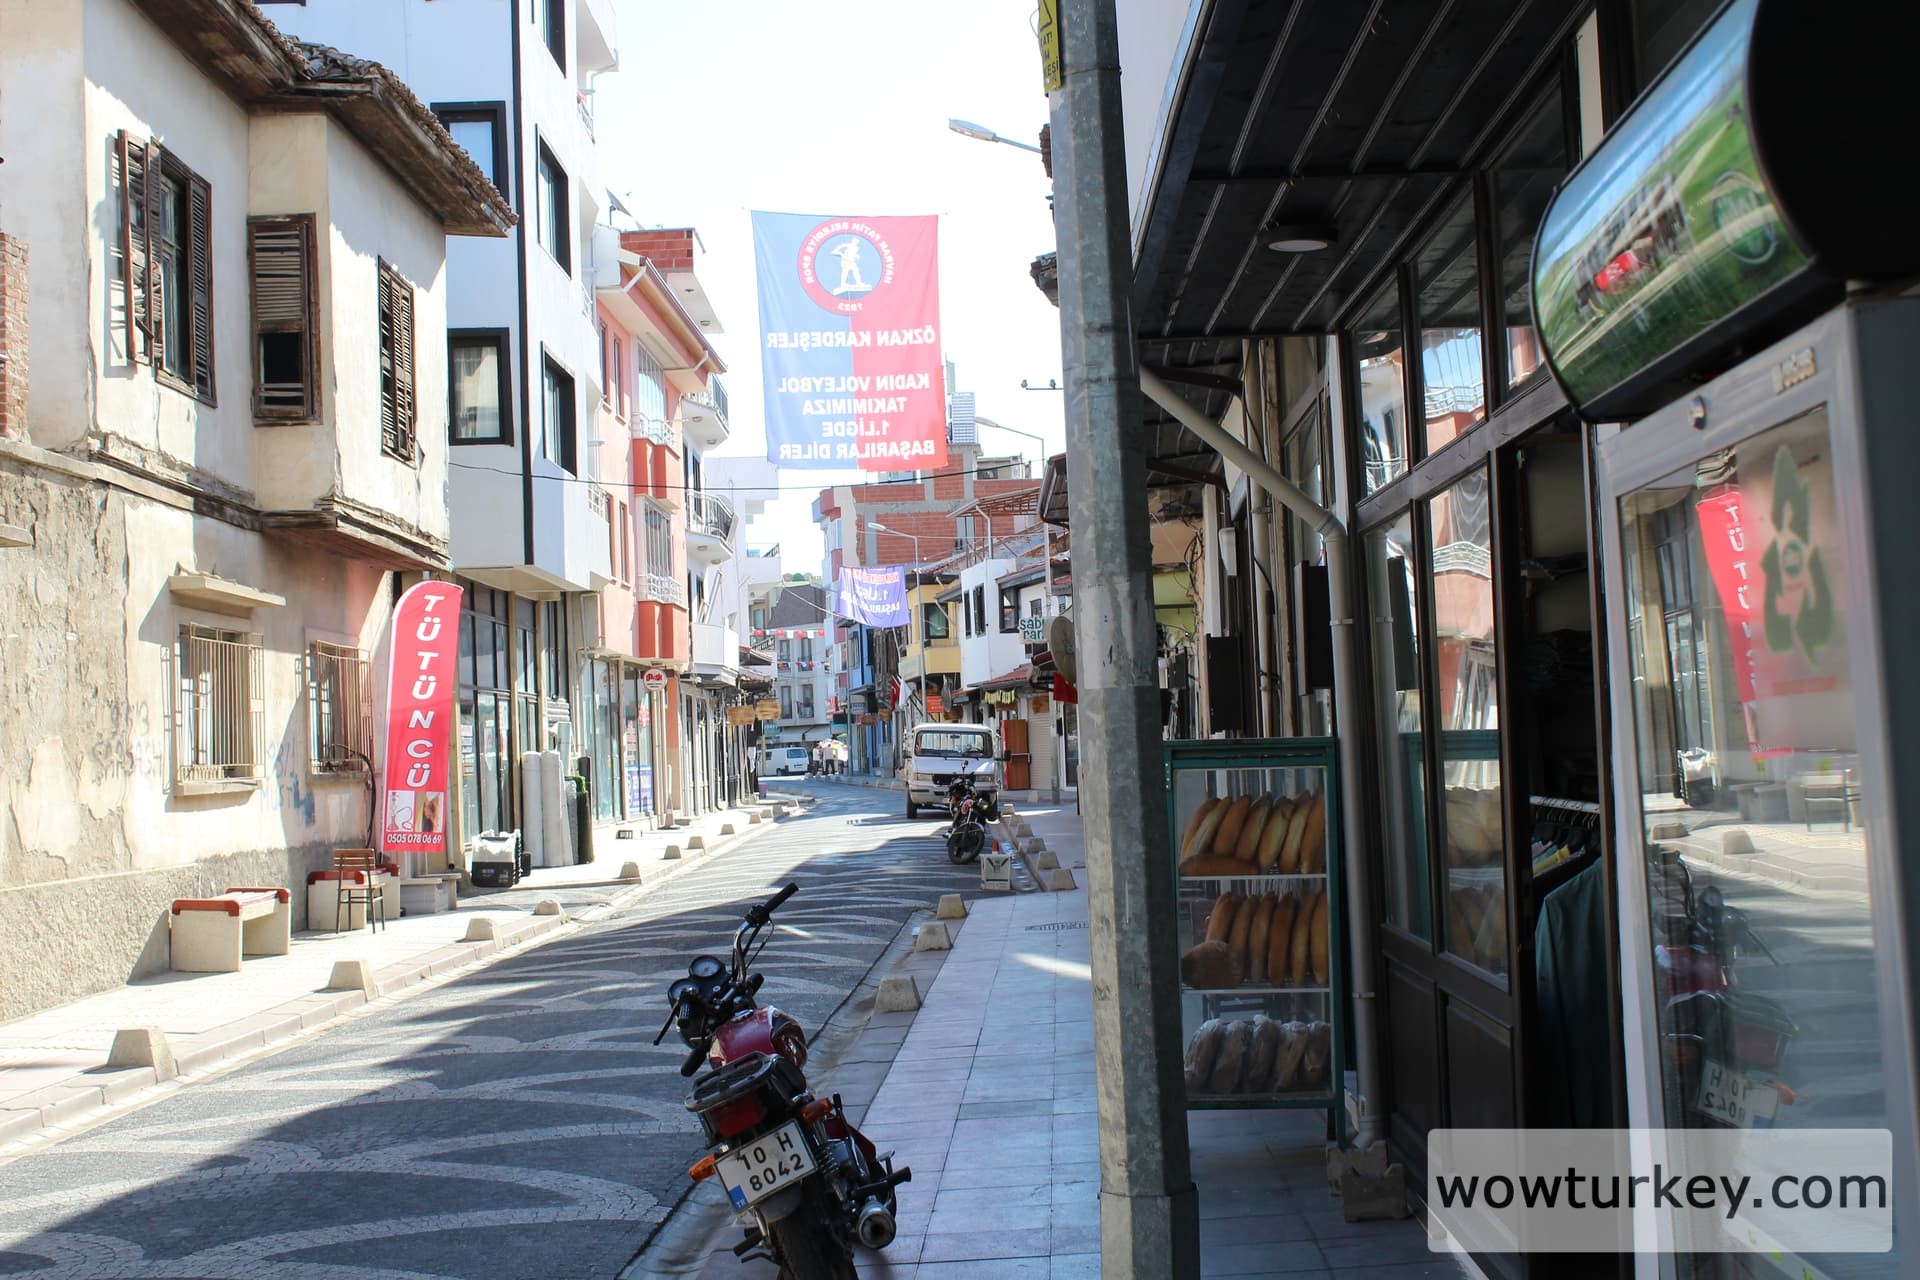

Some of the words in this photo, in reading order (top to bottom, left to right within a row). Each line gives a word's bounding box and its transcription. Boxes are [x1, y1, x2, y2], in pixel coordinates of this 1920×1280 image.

[1019, 617, 1046, 631] sab
[405, 594, 445, 789] TÜTÜNCÜ
[387, 833, 406, 844] 0505
[407, 834, 421, 844] 078
[422, 834, 432, 844] 06
[432, 834, 442, 844] 69
[741, 1146, 766, 1171] 10
[776, 1131, 794, 1153] H
[749, 1153, 804, 1192] 8042
[736, 1199, 747, 1209] TR
